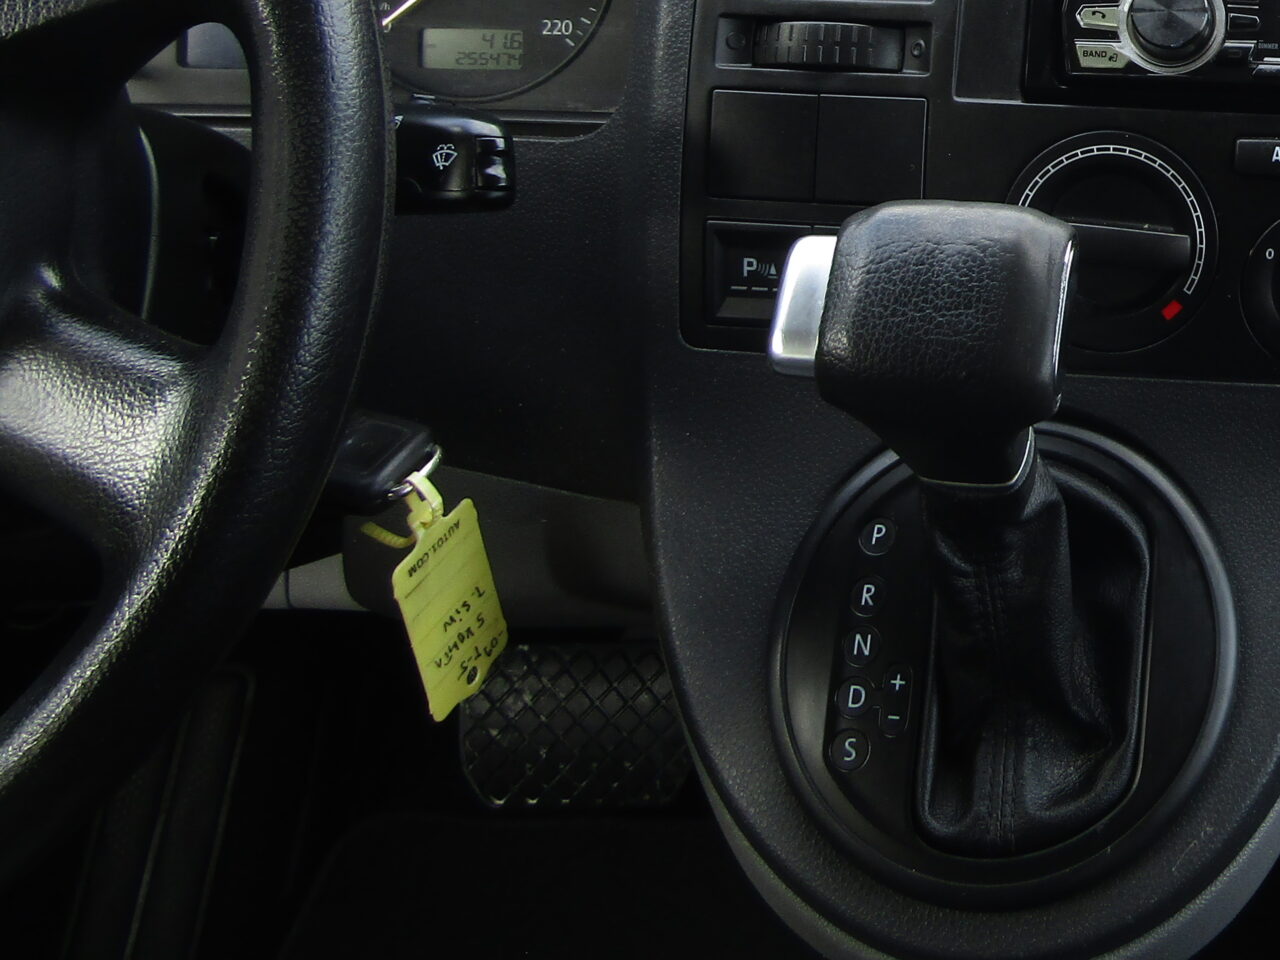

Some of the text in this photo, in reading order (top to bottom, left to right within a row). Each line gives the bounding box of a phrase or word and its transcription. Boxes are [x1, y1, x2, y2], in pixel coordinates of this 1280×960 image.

[542, 19, 573, 36] 220
[1082, 49, 1108, 58] BAND
[1265, 248, 1275, 260] 0
[871, 524, 886, 545] P
[408, 519, 460, 577] AUTO1.COM
[860, 584, 875, 606] R
[853, 633, 872, 656] N
[847, 685, 866, 709] D
[843, 738, 857, 761] S
